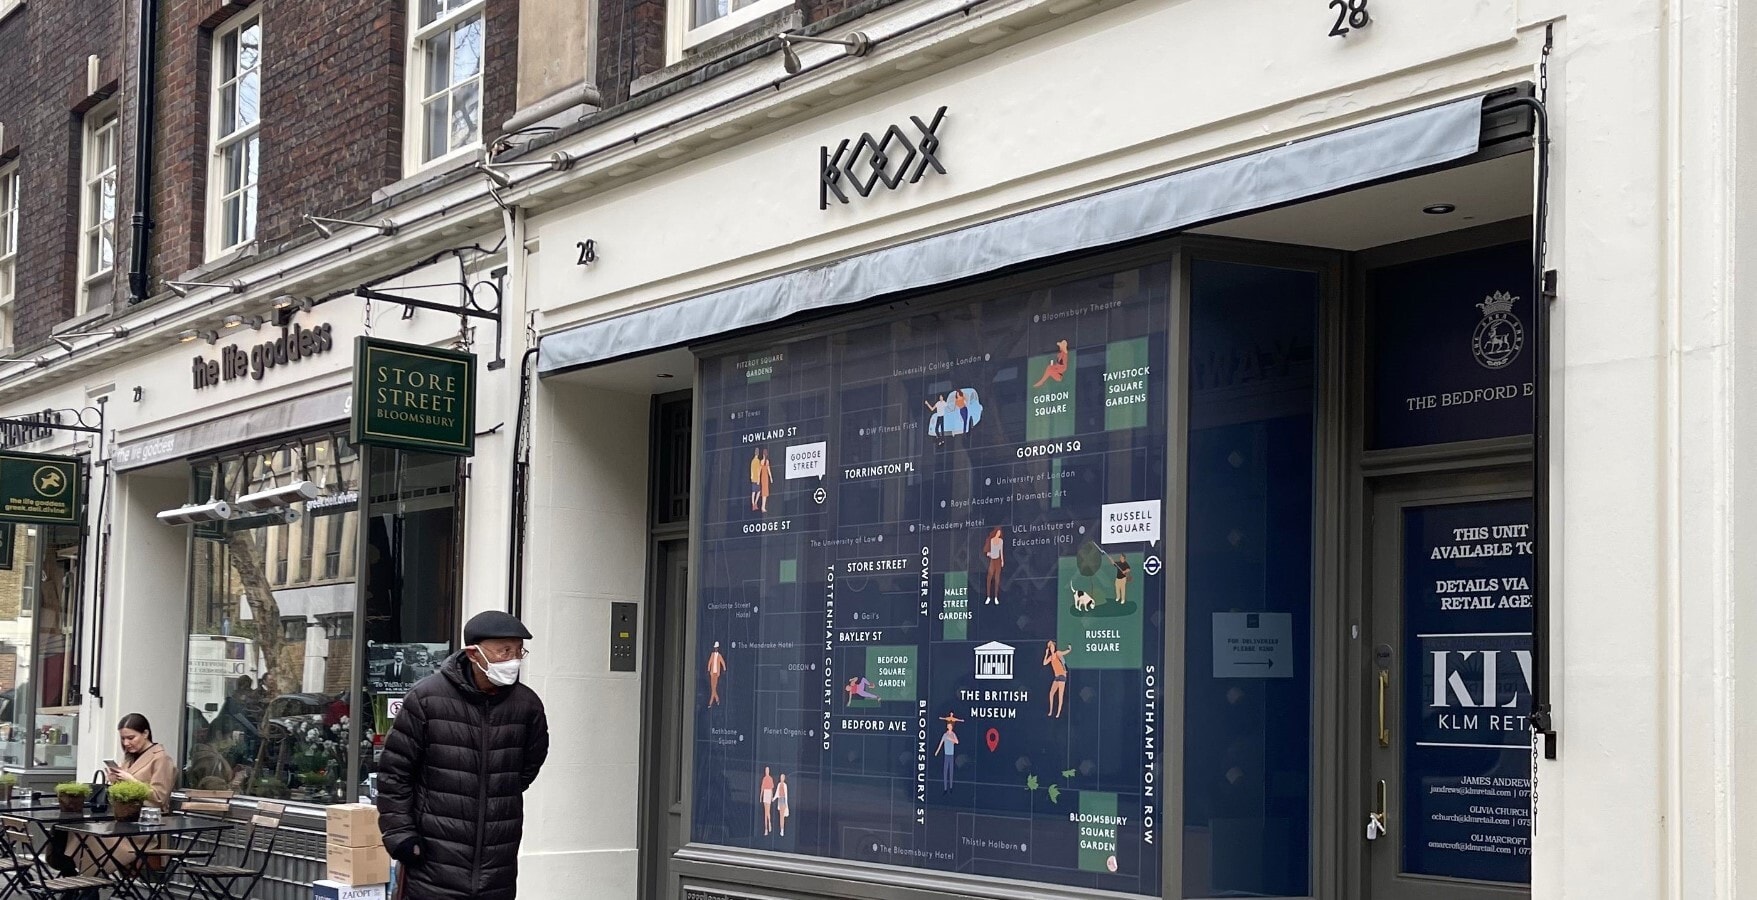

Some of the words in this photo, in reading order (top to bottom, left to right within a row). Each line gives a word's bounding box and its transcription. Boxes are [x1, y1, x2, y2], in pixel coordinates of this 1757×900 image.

[1328, 0, 1369, 37] 28
[820, 106, 947, 210] KOOX
[577, 239, 595, 265] 28
[1042, 307, 1088, 321] Bloomsbury
[1090, 300, 1122, 312] Theatre
[192, 355, 219, 390] the
[222, 344, 248, 381] life
[251, 322, 332, 380] goddess
[736, 359, 760, 370] FITZROY
[761, 354, 783, 364] SQUARE
[746, 367, 773, 377] GARDENS
[893, 365, 926, 377] University
[929, 361, 954, 372] College
[956, 355, 981, 366] London
[378, 366, 455, 393] STORE
[1103, 366, 1150, 381] TAVISTOCK
[1109, 381, 1143, 394] SQUARE
[378, 387, 455, 413] STREET
[1034, 391, 1069, 404] GORDON
[1105, 394, 1146, 407] GARDENS
[1407, 395, 1437, 411] THE
[1441, 384, 1517, 407] BEDFORD
[1035, 404, 1067, 416] SQUARE
[377, 409, 455, 428] BLOOMSBURY
[742, 429, 785, 443] HOWLAND
[787, 427, 798, 437] ST
[866, 428, 877, 436] DW
[878, 424, 901, 433] Fitness
[903, 422, 918, 430] First
[790, 450, 821, 461] GOODGE
[1016, 442, 1063, 458] GORDON
[1066, 440, 1081, 452] SQ
[793, 461, 818, 470] STREET
[845, 463, 901, 479] TORRINGTON
[904, 461, 914, 472] PL
[997, 474, 1034, 485] University
[1036, 473, 1045, 481] of
[1047, 470, 1075, 480] London
[950, 499, 970, 510] Royal
[971, 496, 1003, 507] Academy
[1006, 494, 1014, 502] of
[1016, 491, 1051, 501] Dramatic
[1054, 489, 1067, 498] Art
[1110, 510, 1152, 522] RUSSELL
[743, 522, 778, 534] GOODGE
[781, 521, 791, 530] ST
[918, 523, 930, 531] The
[932, 520, 962, 532] Academy
[965, 518, 984, 527] Hotel
[1012, 524, 1027, 533] UCL
[1029, 522, 1063, 532] Institute
[1065, 521, 1074, 529] of
[1110, 523, 1151, 534] SQUARE
[1453, 527, 1489, 541] THIS
[1492, 524, 1529, 538] UNIT
[823, 537, 854, 547] University
[855, 535, 862, 543] of
[863, 535, 876, 543] Law
[1012, 537, 1050, 547] Education
[1053, 534, 1074, 546] (IOE)
[1430, 543, 1512, 559] AVAILABLE
[848, 561, 873, 572] STORE
[876, 559, 907, 571] STREET
[920, 546, 929, 596] GOWER
[1436, 578, 1499, 593] DETAILS
[1502, 577, 1529, 590] VIA
[944, 588, 968, 597] MALET
[825, 565, 834, 650] TOTTENHAM
[920, 601, 928, 616] ST
[943, 600, 968, 608] STREET
[1441, 596, 1495, 610] RETAIL
[861, 612, 879, 620] Gail's
[938, 612, 972, 620] GARDENS
[839, 632, 870, 642] BAYLEY
[872, 631, 883, 641] ST
[1086, 630, 1120, 638] RUSSELL
[1086, 643, 1120, 652] SQUARE
[879, 667, 906, 675] SQUARE
[824, 657, 832, 705] COURT
[961, 690, 980, 700] THE
[984, 691, 1028, 702] BRITISH
[971, 708, 1016, 718] MUSEUM
[842, 720, 884, 730] BEDFORD
[888, 721, 907, 731] AVE
[1439, 714, 1478, 729] KLM
[763, 727, 782, 735] Planet
[784, 728, 807, 737] Organic
[823, 711, 831, 750] ROAD
[1144, 666, 1155, 797] SOUTHAMPTON
[918, 700, 927, 802] BLOOMSBURY
[1461, 776, 1491, 786] JAMES
[1430, 785, 1511, 797] jandrews@klmretail.com
[917, 808, 925, 824] ST
[1470, 805, 1493, 814] OLIVIA
[1495, 807, 1528, 817] CHURCH
[1070, 813, 1127, 825] BLOOMSBURY
[1144, 805, 1153, 844] ROW
[1431, 813, 1510, 825] ochurch@klmretail.com
[1081, 827, 1115, 838] SQUARE
[962, 837, 986, 848] Thistle
[988, 839, 1018, 850] Holborn
[1080, 840, 1115, 851] GARDEN
[1471, 834, 1484, 842] OLI
[1485, 835, 1527, 845] MARCROFT
[880, 844, 892, 853] The
[893, 846, 933, 858] Bloomsbury
[935, 852, 954, 860] Hotel
[1428, 841, 1511, 854] omarcroft@klmretail.com
